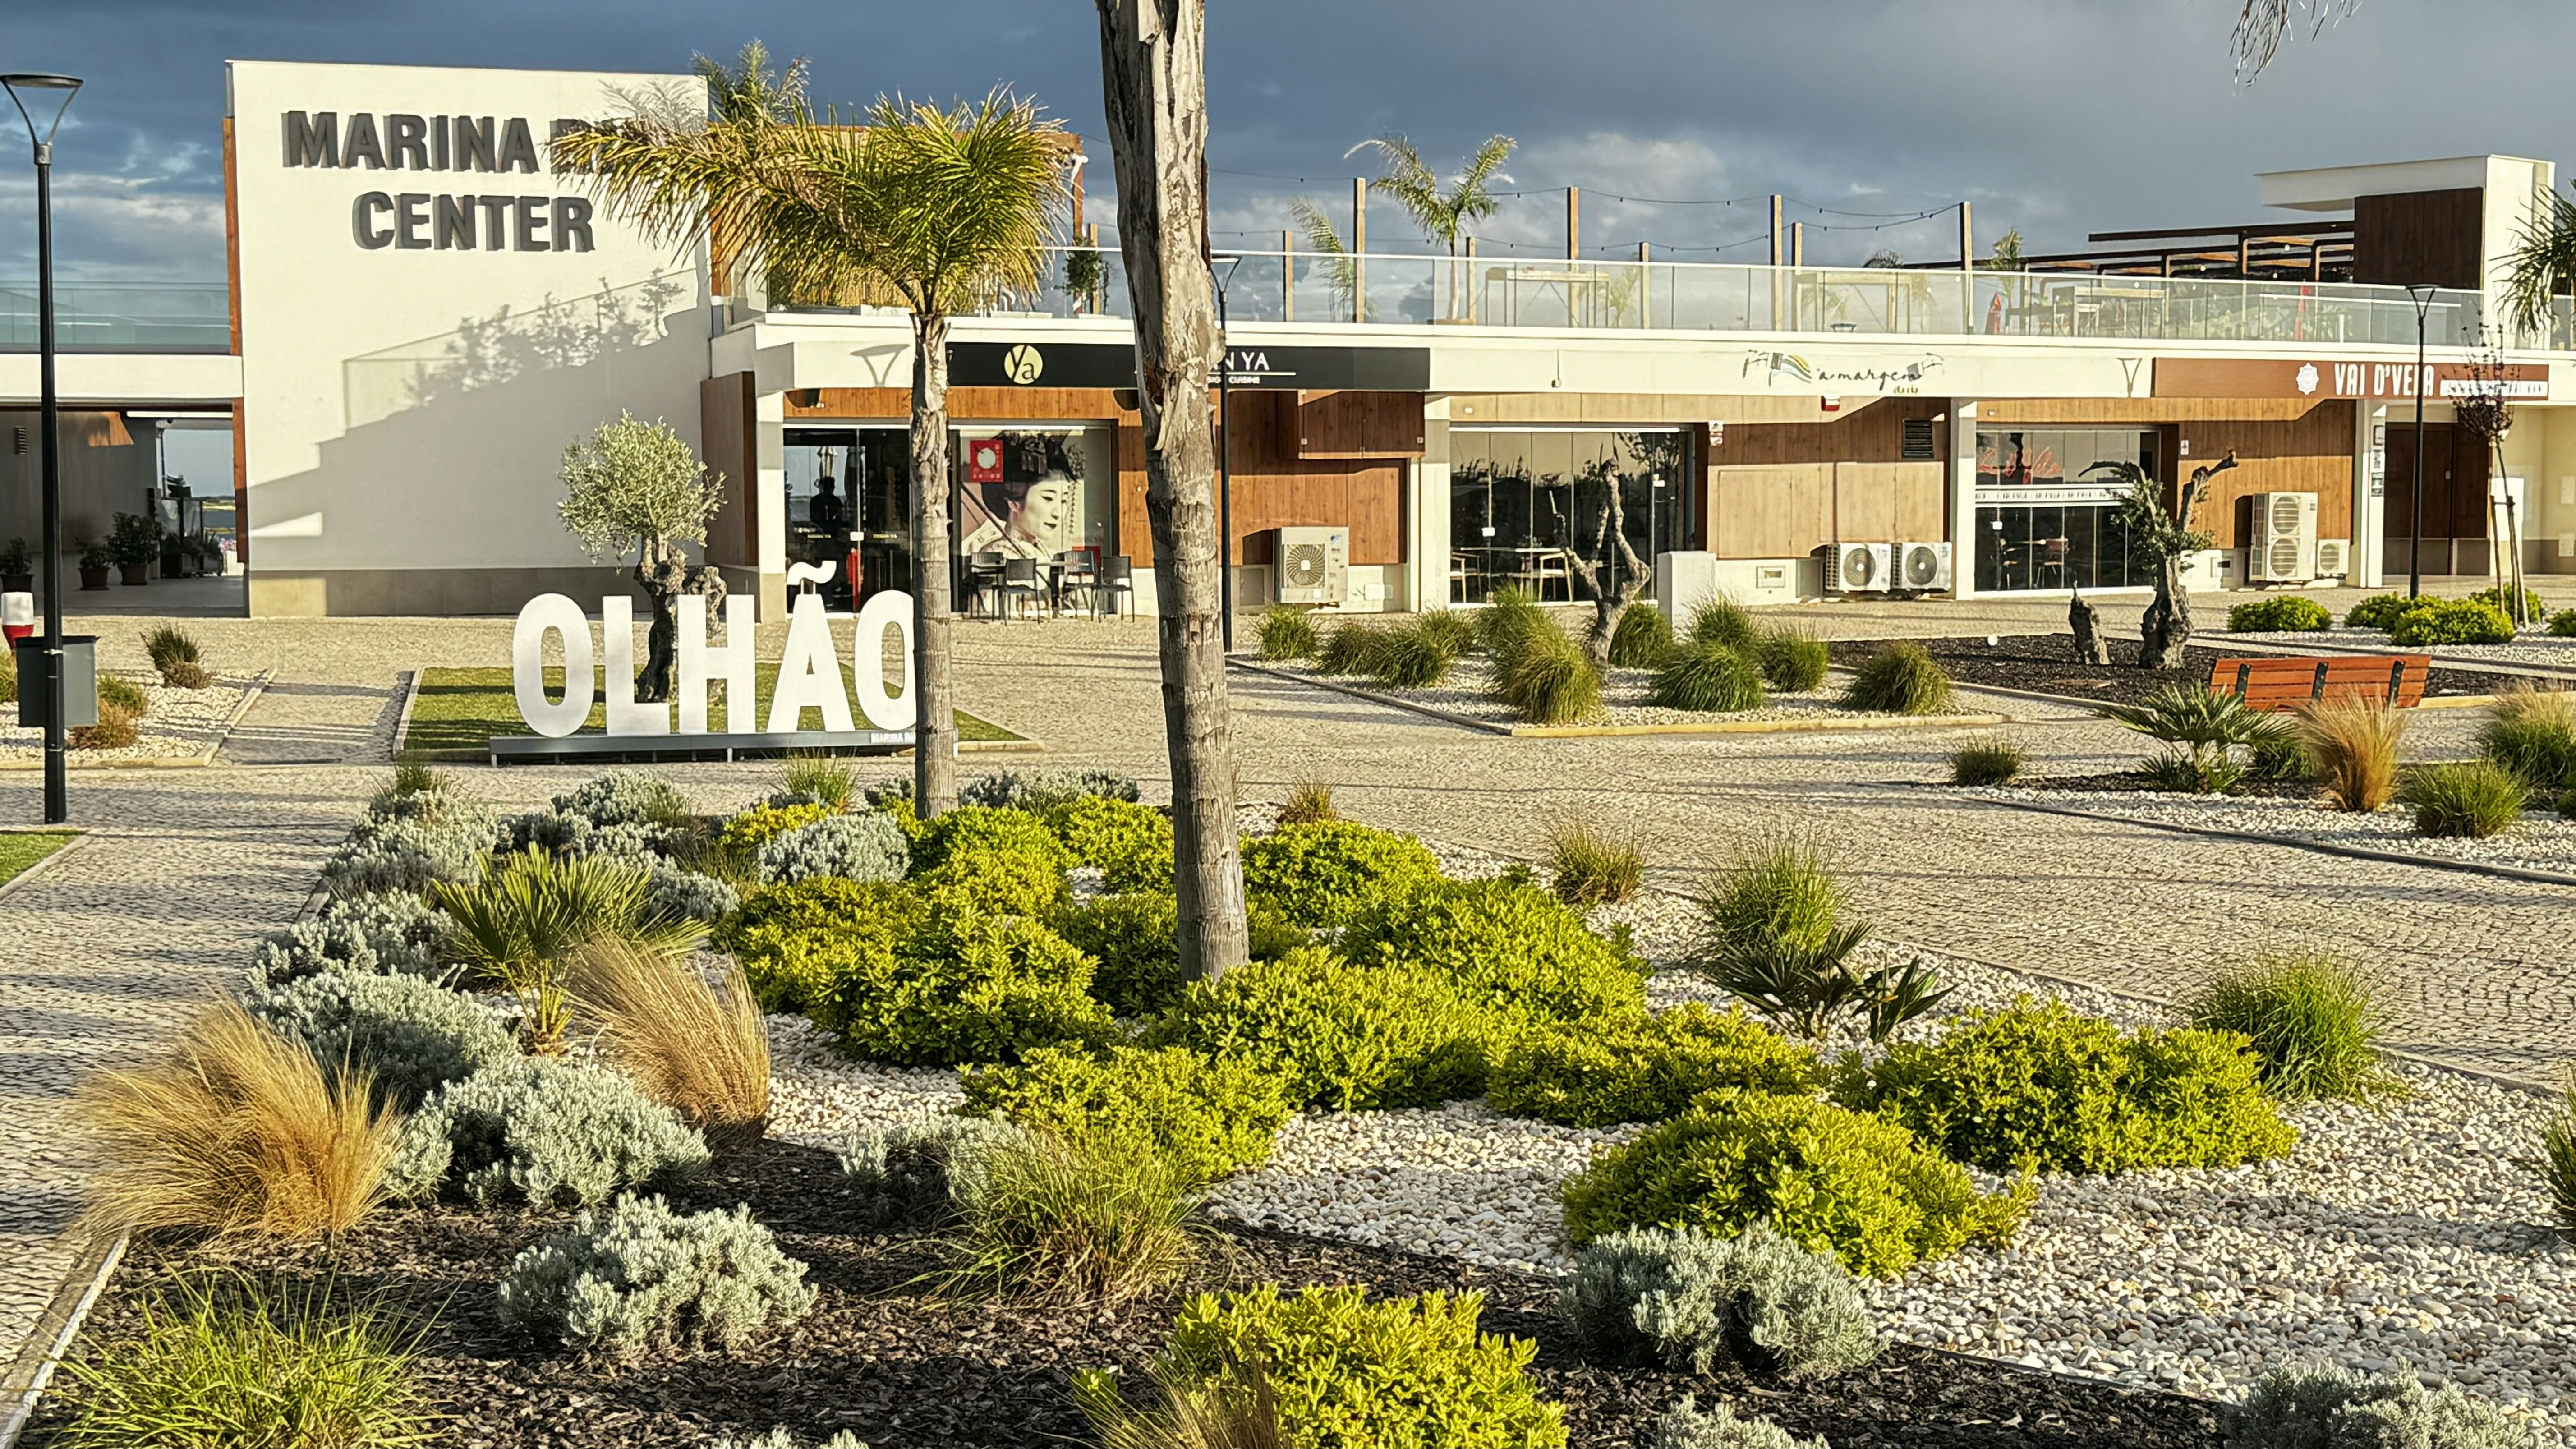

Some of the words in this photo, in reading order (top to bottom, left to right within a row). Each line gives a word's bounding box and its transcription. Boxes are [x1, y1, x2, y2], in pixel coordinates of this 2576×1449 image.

[281, 110, 540, 174] MARINA
[352, 191, 596, 252] CENTER
[2334, 363, 2365, 396] VAI
[513, 560, 916, 738] OLHÃO
